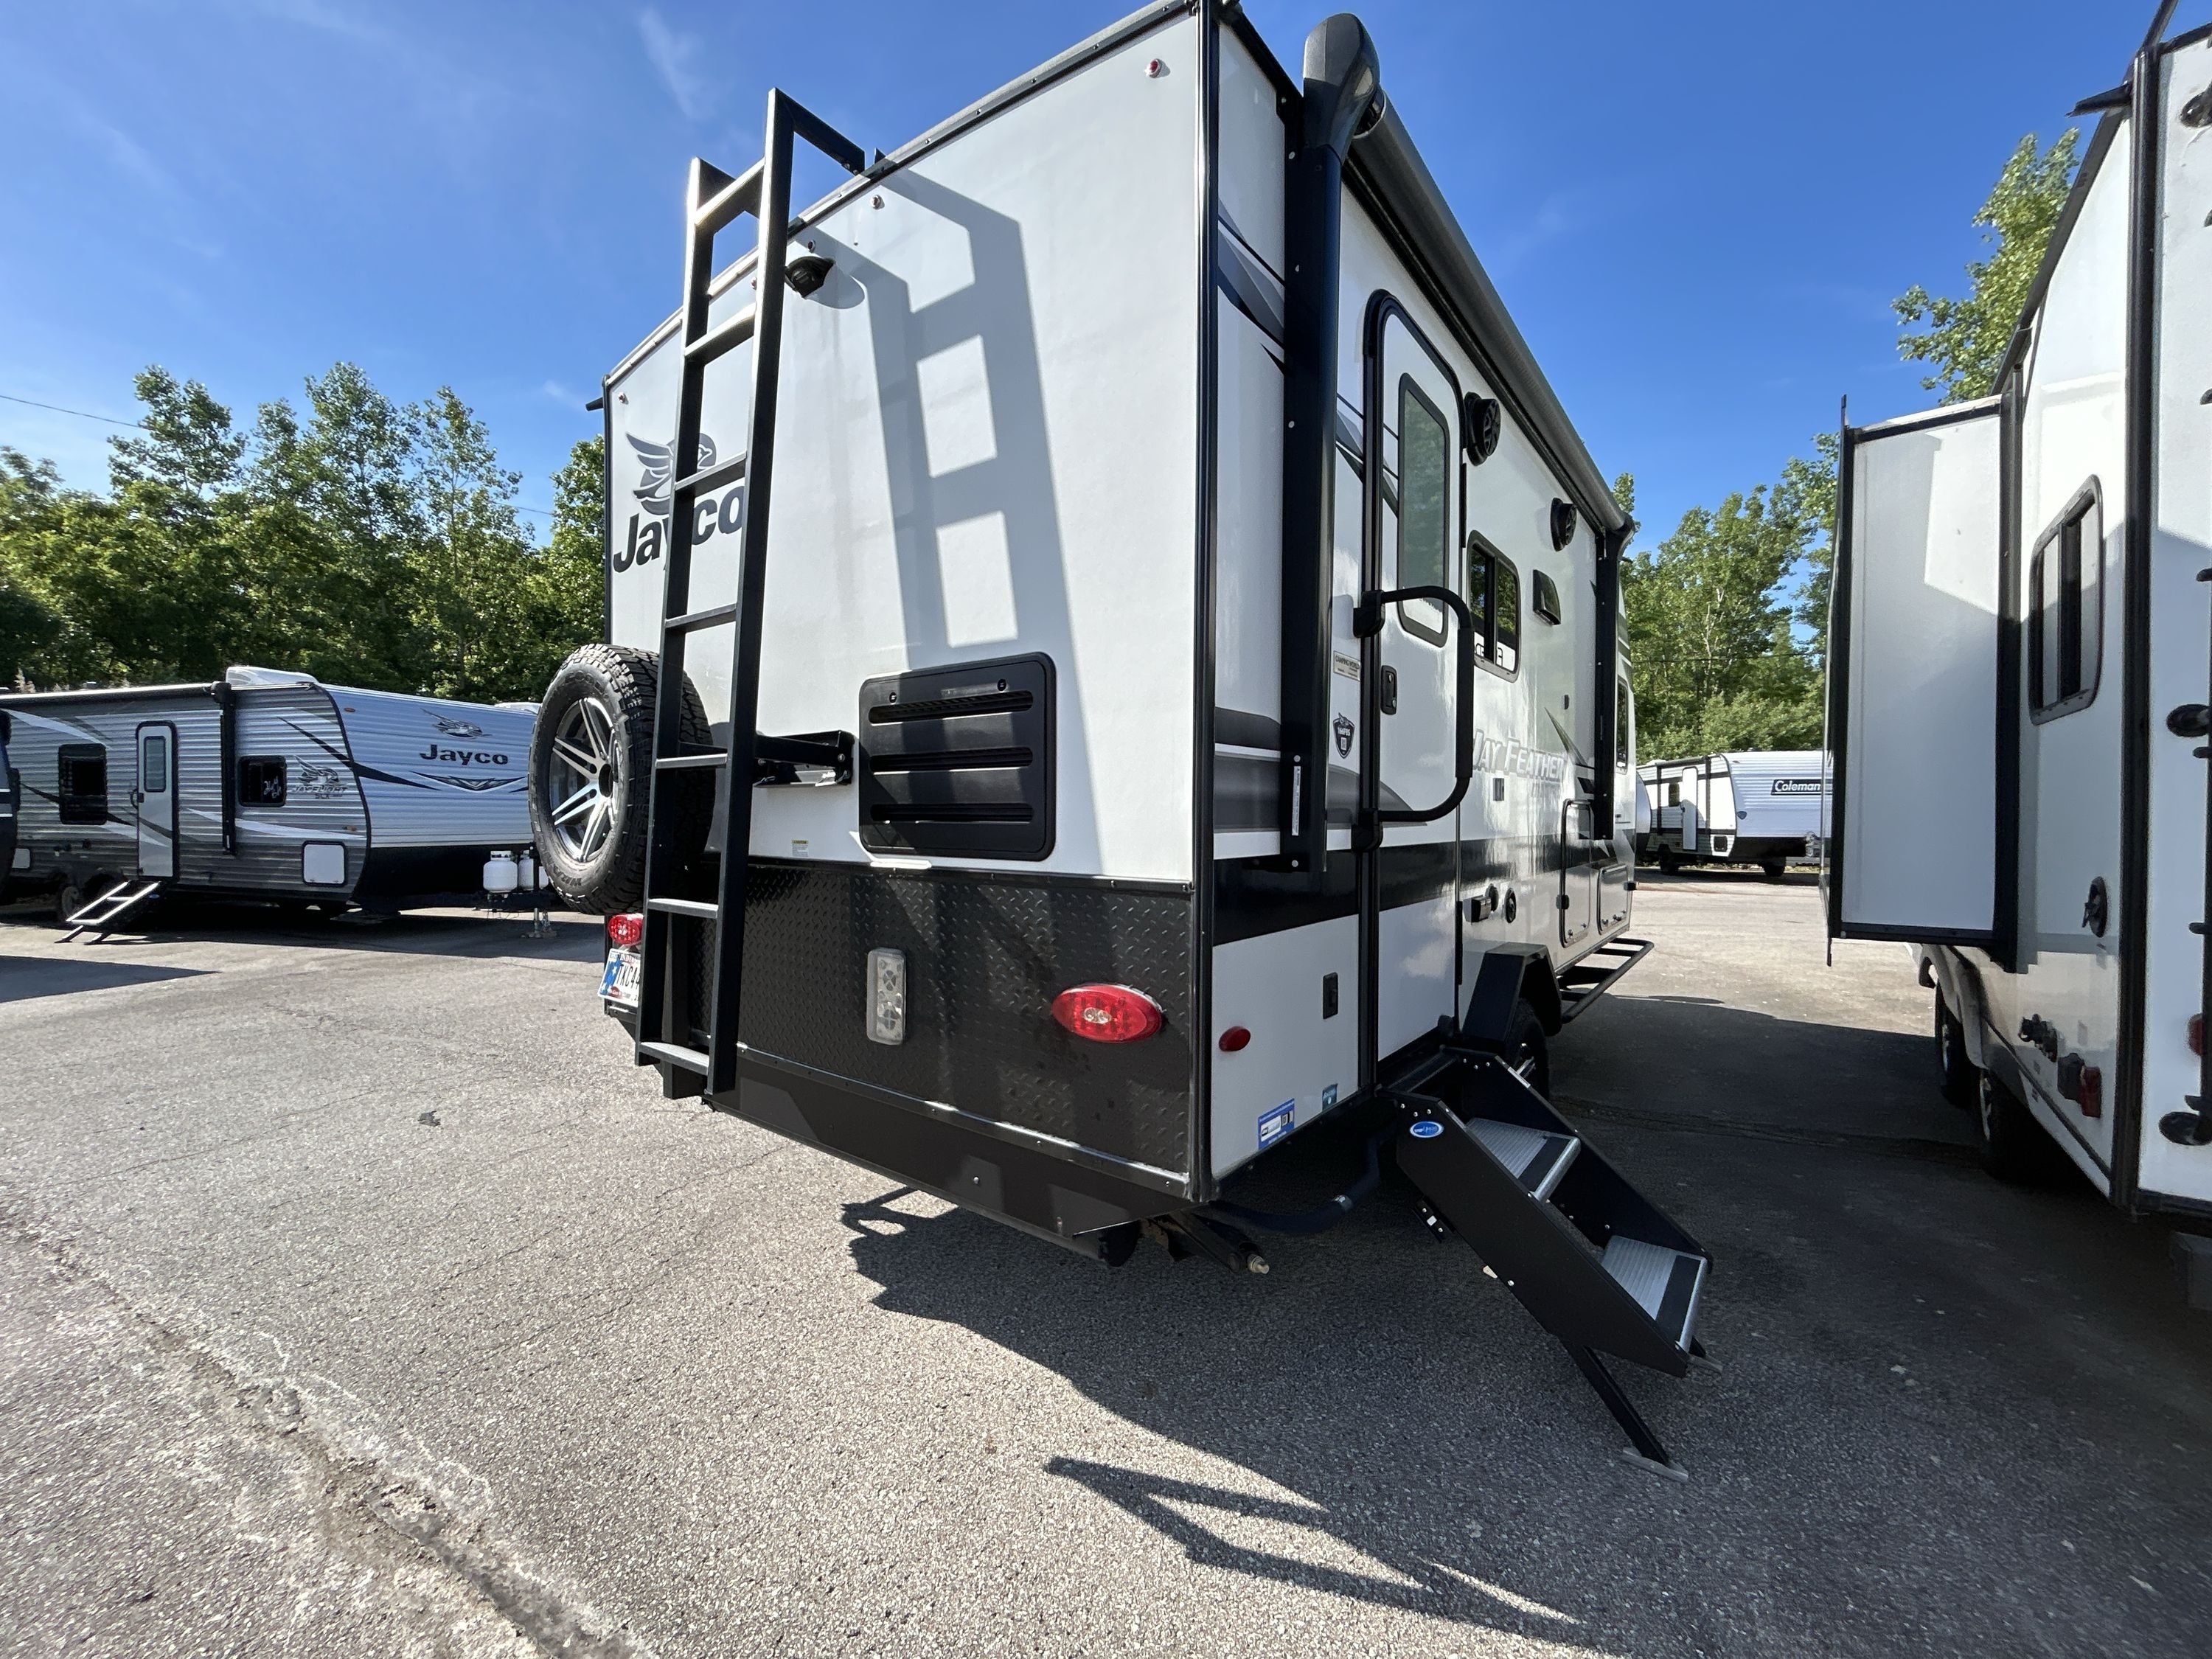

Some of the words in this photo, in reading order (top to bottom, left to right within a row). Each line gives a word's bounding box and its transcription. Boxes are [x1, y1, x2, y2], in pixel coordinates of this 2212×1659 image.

[613, 485, 746, 573] Jaco
[420, 744, 509, 765] Jayco
[1774, 780, 1821, 792] Coleman
